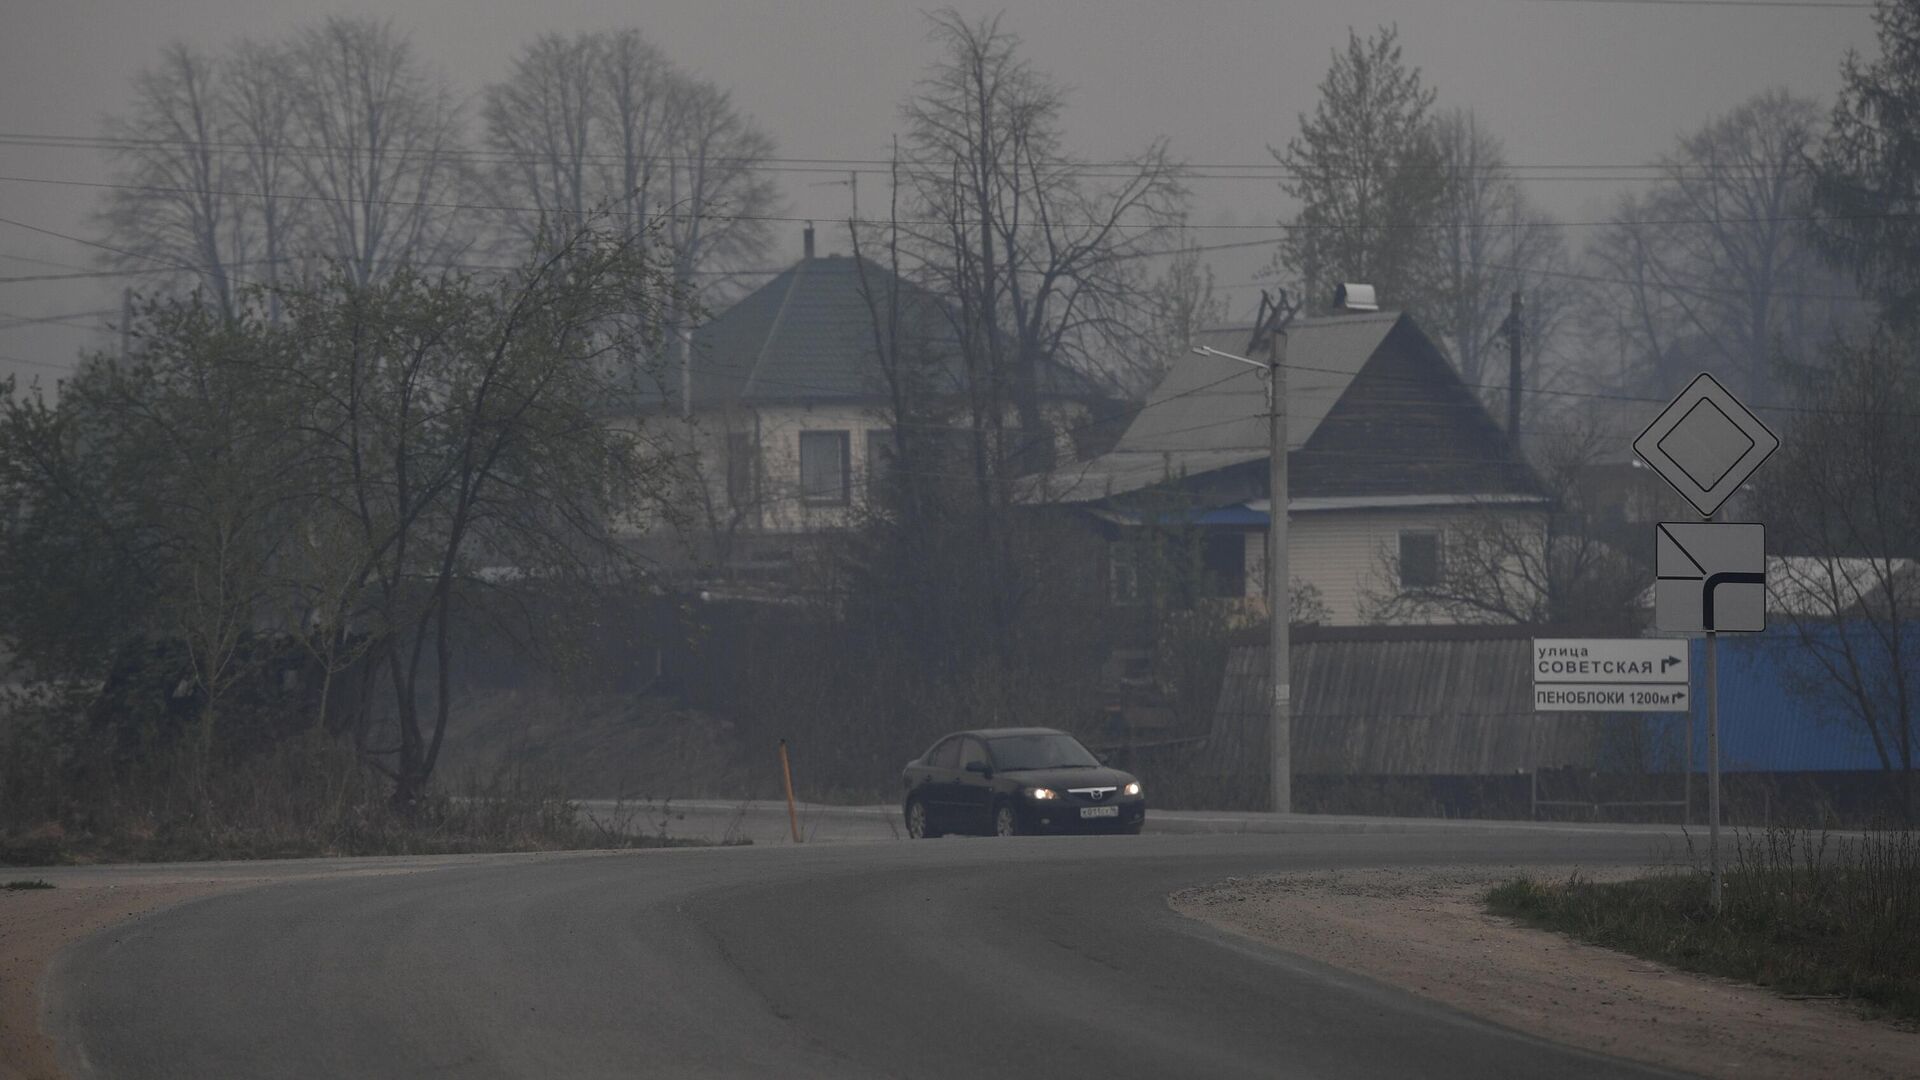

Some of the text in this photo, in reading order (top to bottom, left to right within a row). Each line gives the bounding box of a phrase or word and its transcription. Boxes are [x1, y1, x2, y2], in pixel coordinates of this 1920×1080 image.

[1538, 647, 1589, 659] улица
[1538, 661, 1653, 674] СОВЕТСКАЯ
[1537, 691, 1669, 704] ПЕНОБЛОКИ 1200м
